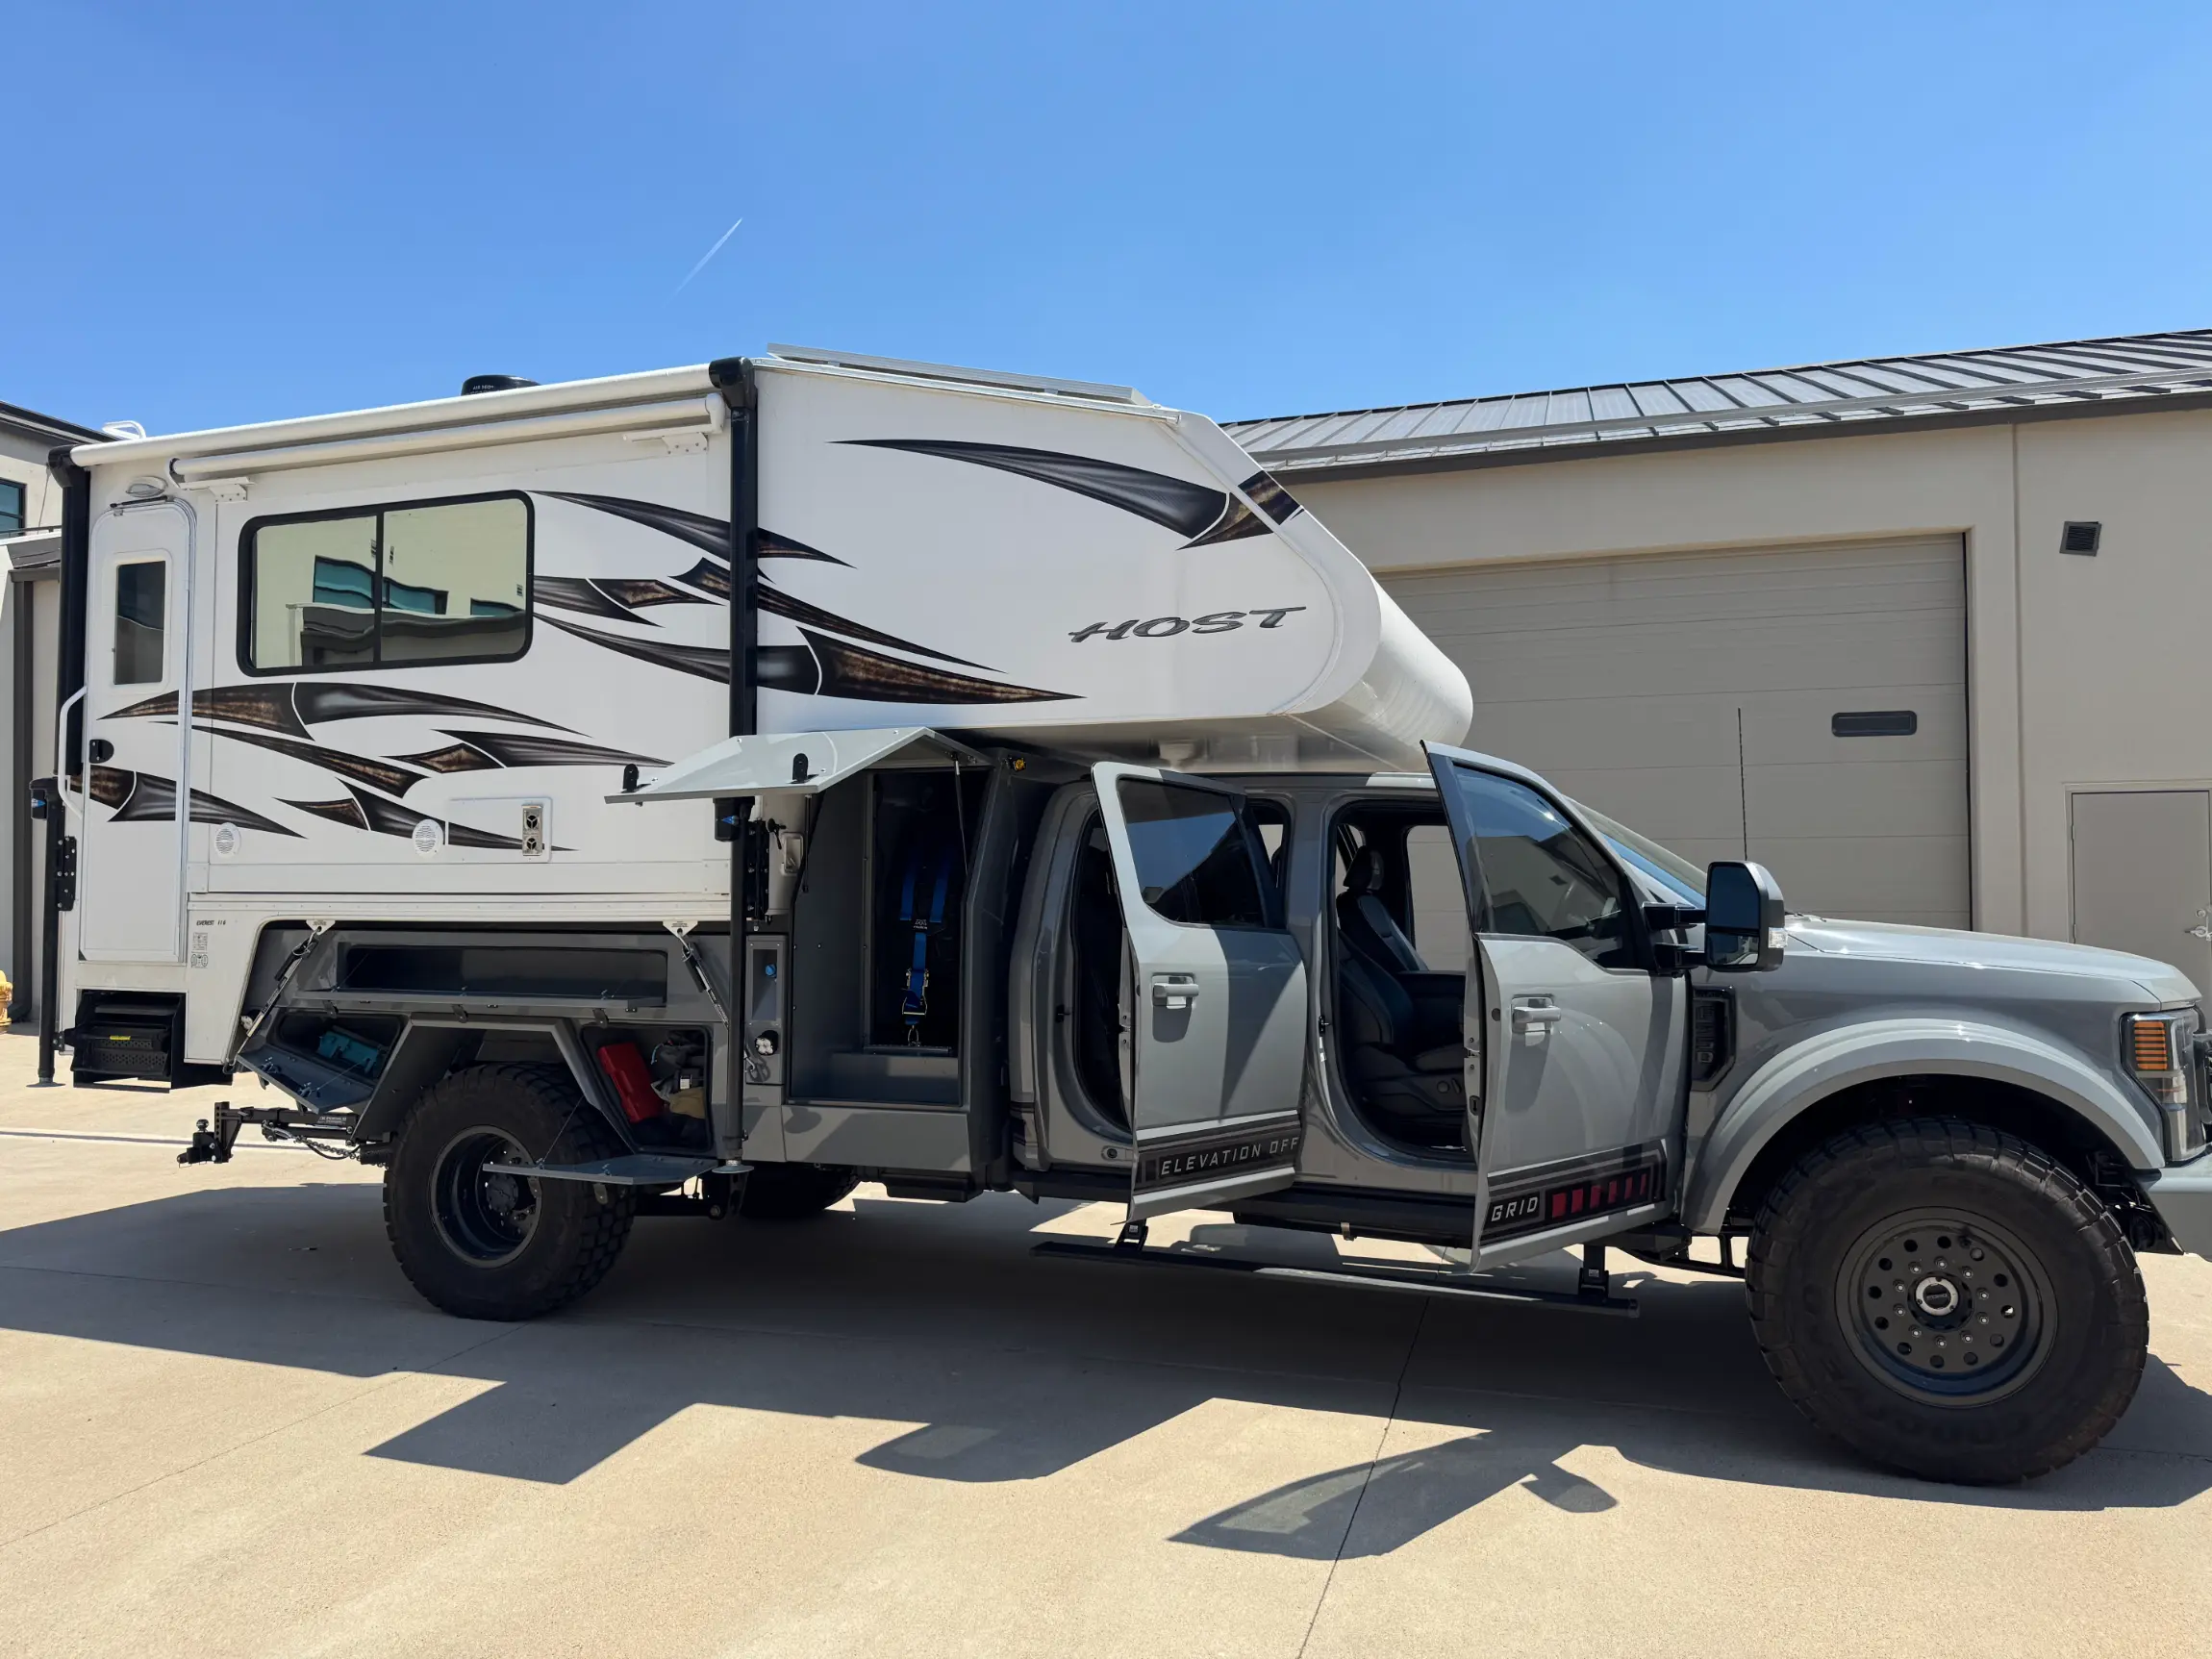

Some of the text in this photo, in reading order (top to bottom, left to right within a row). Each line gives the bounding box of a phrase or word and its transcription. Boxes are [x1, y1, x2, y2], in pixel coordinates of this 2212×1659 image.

[1068, 606, 1307, 642] HOST
[1161, 1137, 1299, 1175] ELEVATION OFF
[1491, 1196, 1538, 1222] GRID
